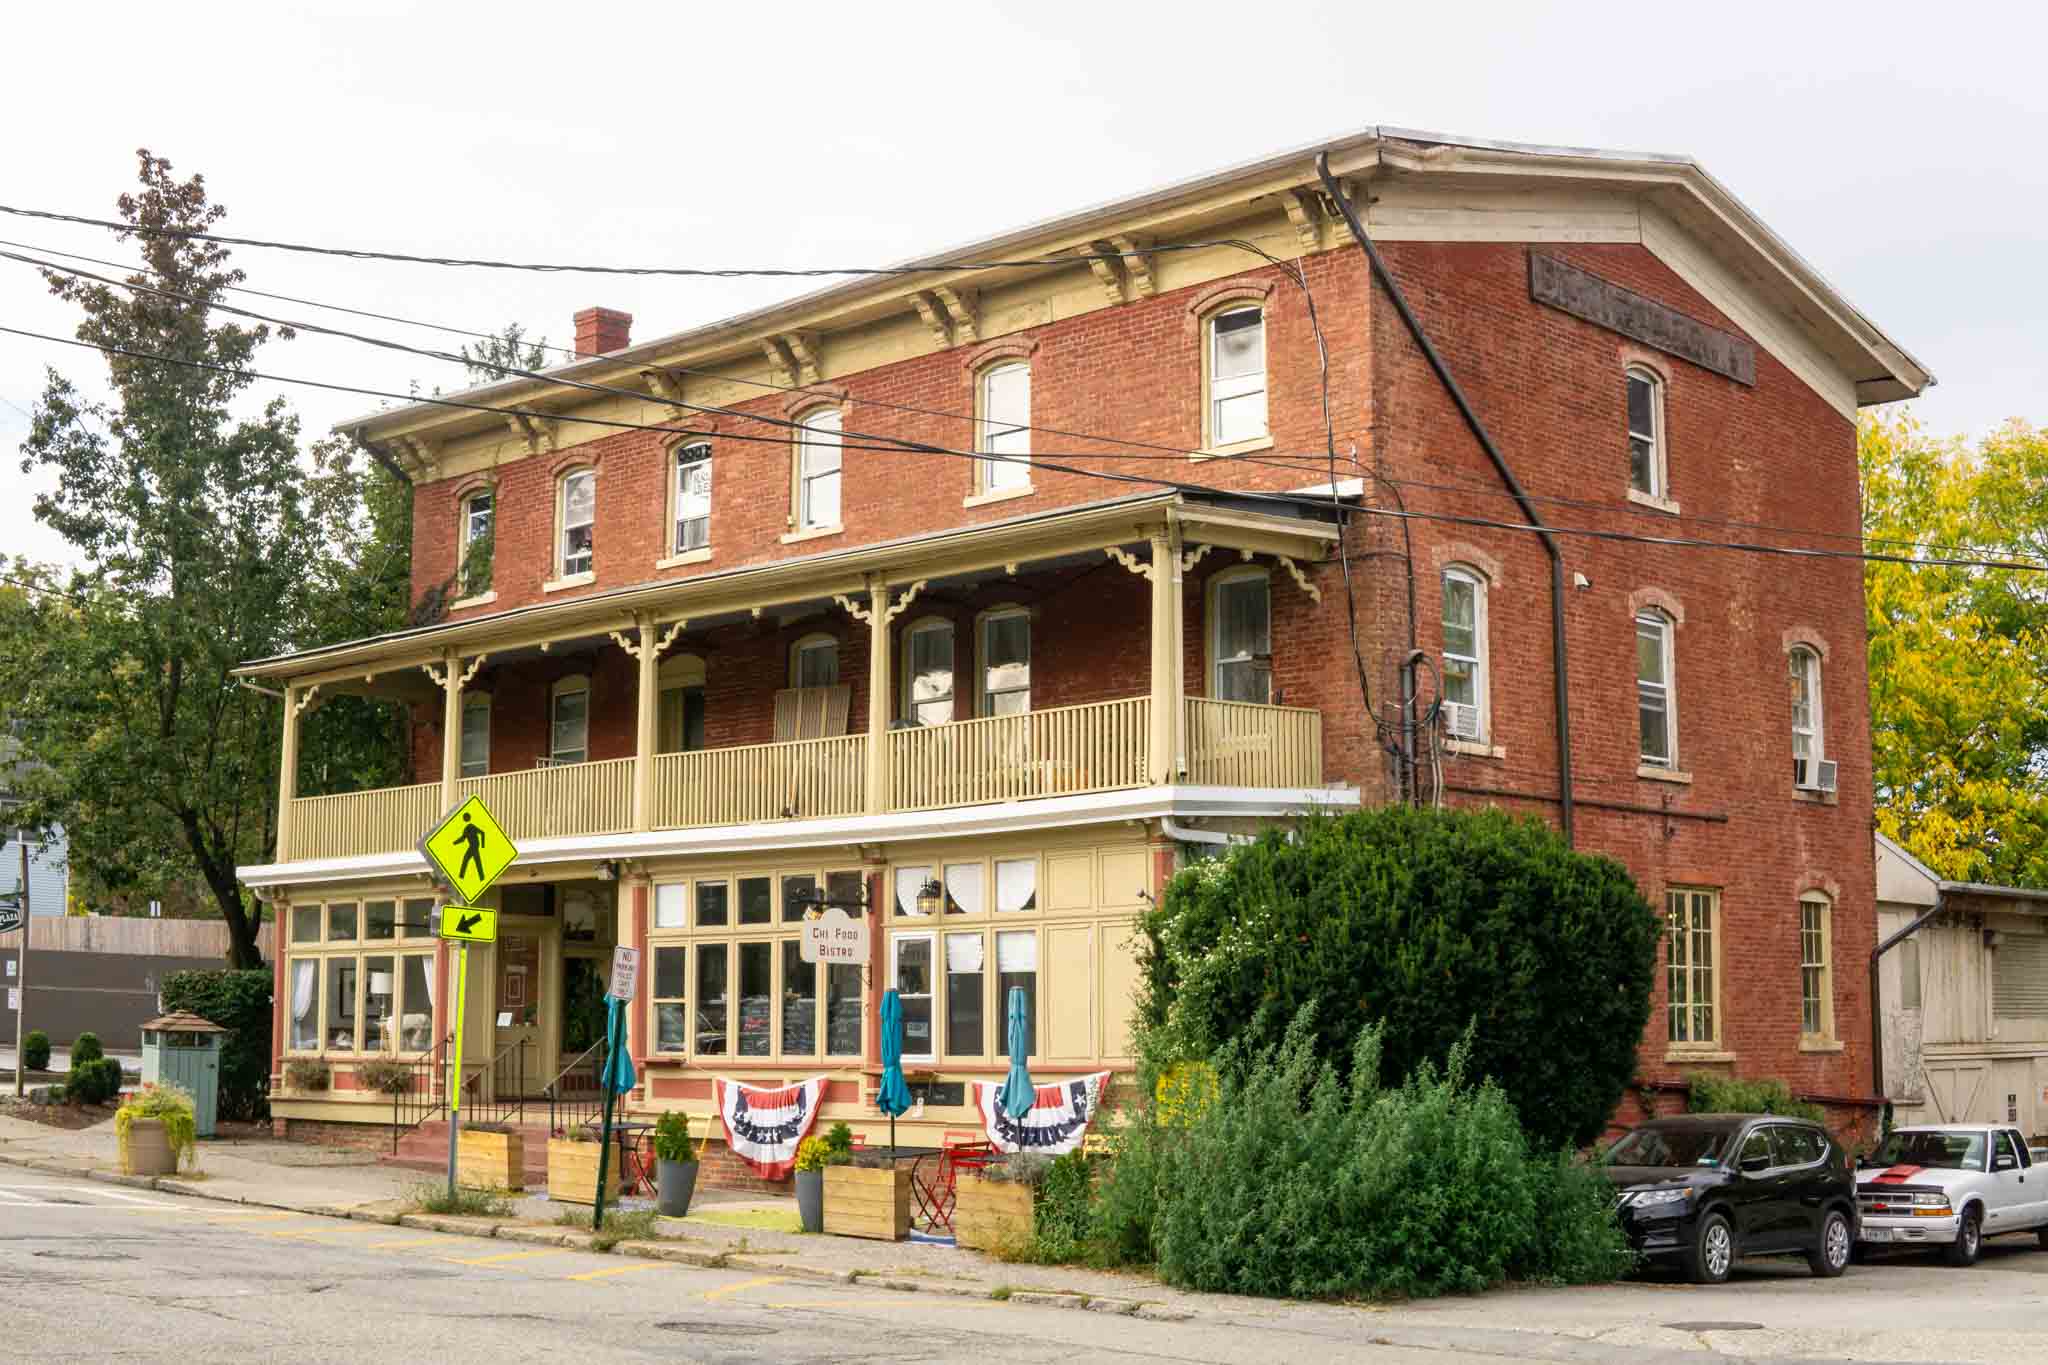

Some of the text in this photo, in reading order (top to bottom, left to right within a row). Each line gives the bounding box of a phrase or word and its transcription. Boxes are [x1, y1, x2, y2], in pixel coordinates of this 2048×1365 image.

[836, 928, 858, 940] FOOD
[820, 944, 852, 956] BISTRO
[623, 952, 632, 961] NO
